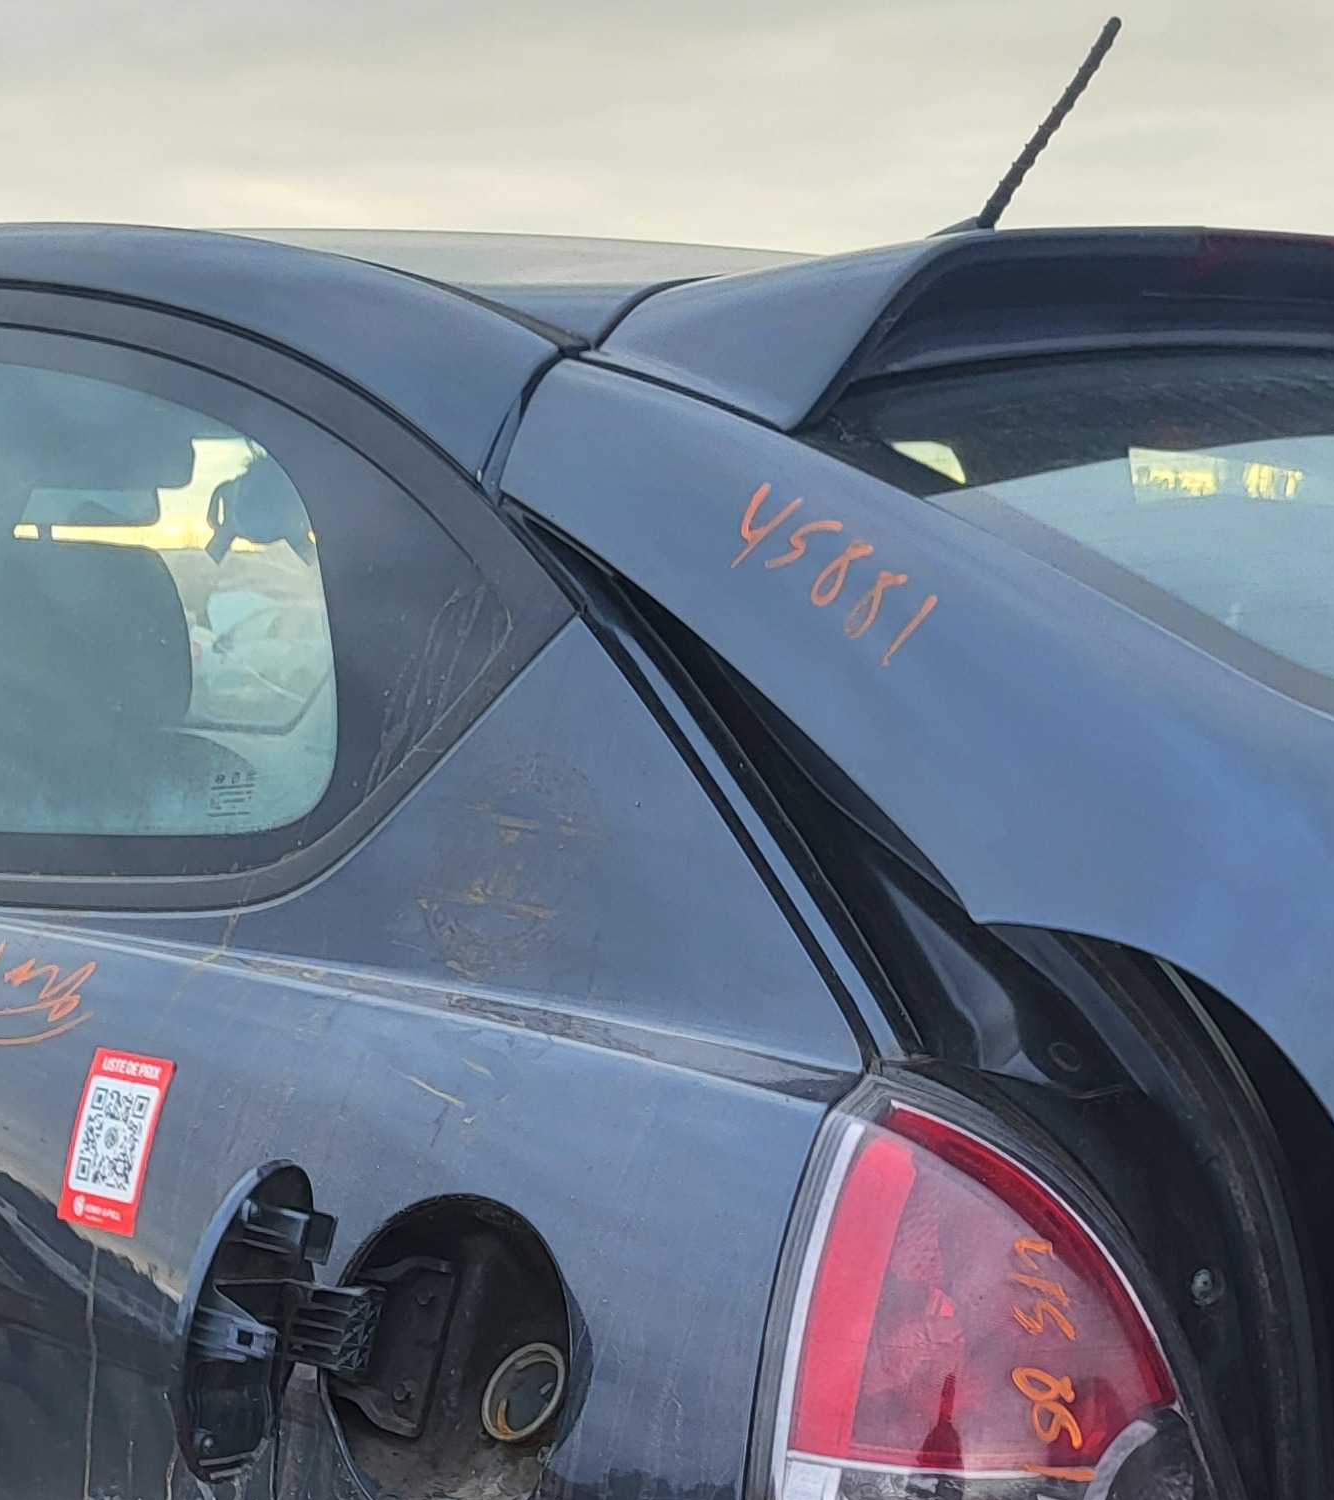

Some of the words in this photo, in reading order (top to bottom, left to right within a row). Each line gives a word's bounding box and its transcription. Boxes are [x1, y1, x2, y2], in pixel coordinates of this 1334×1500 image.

[730, 480, 939, 668] 45881
[102, 1056, 130, 1074] LISTE
[140, 1062, 162, 1080] PRIX
